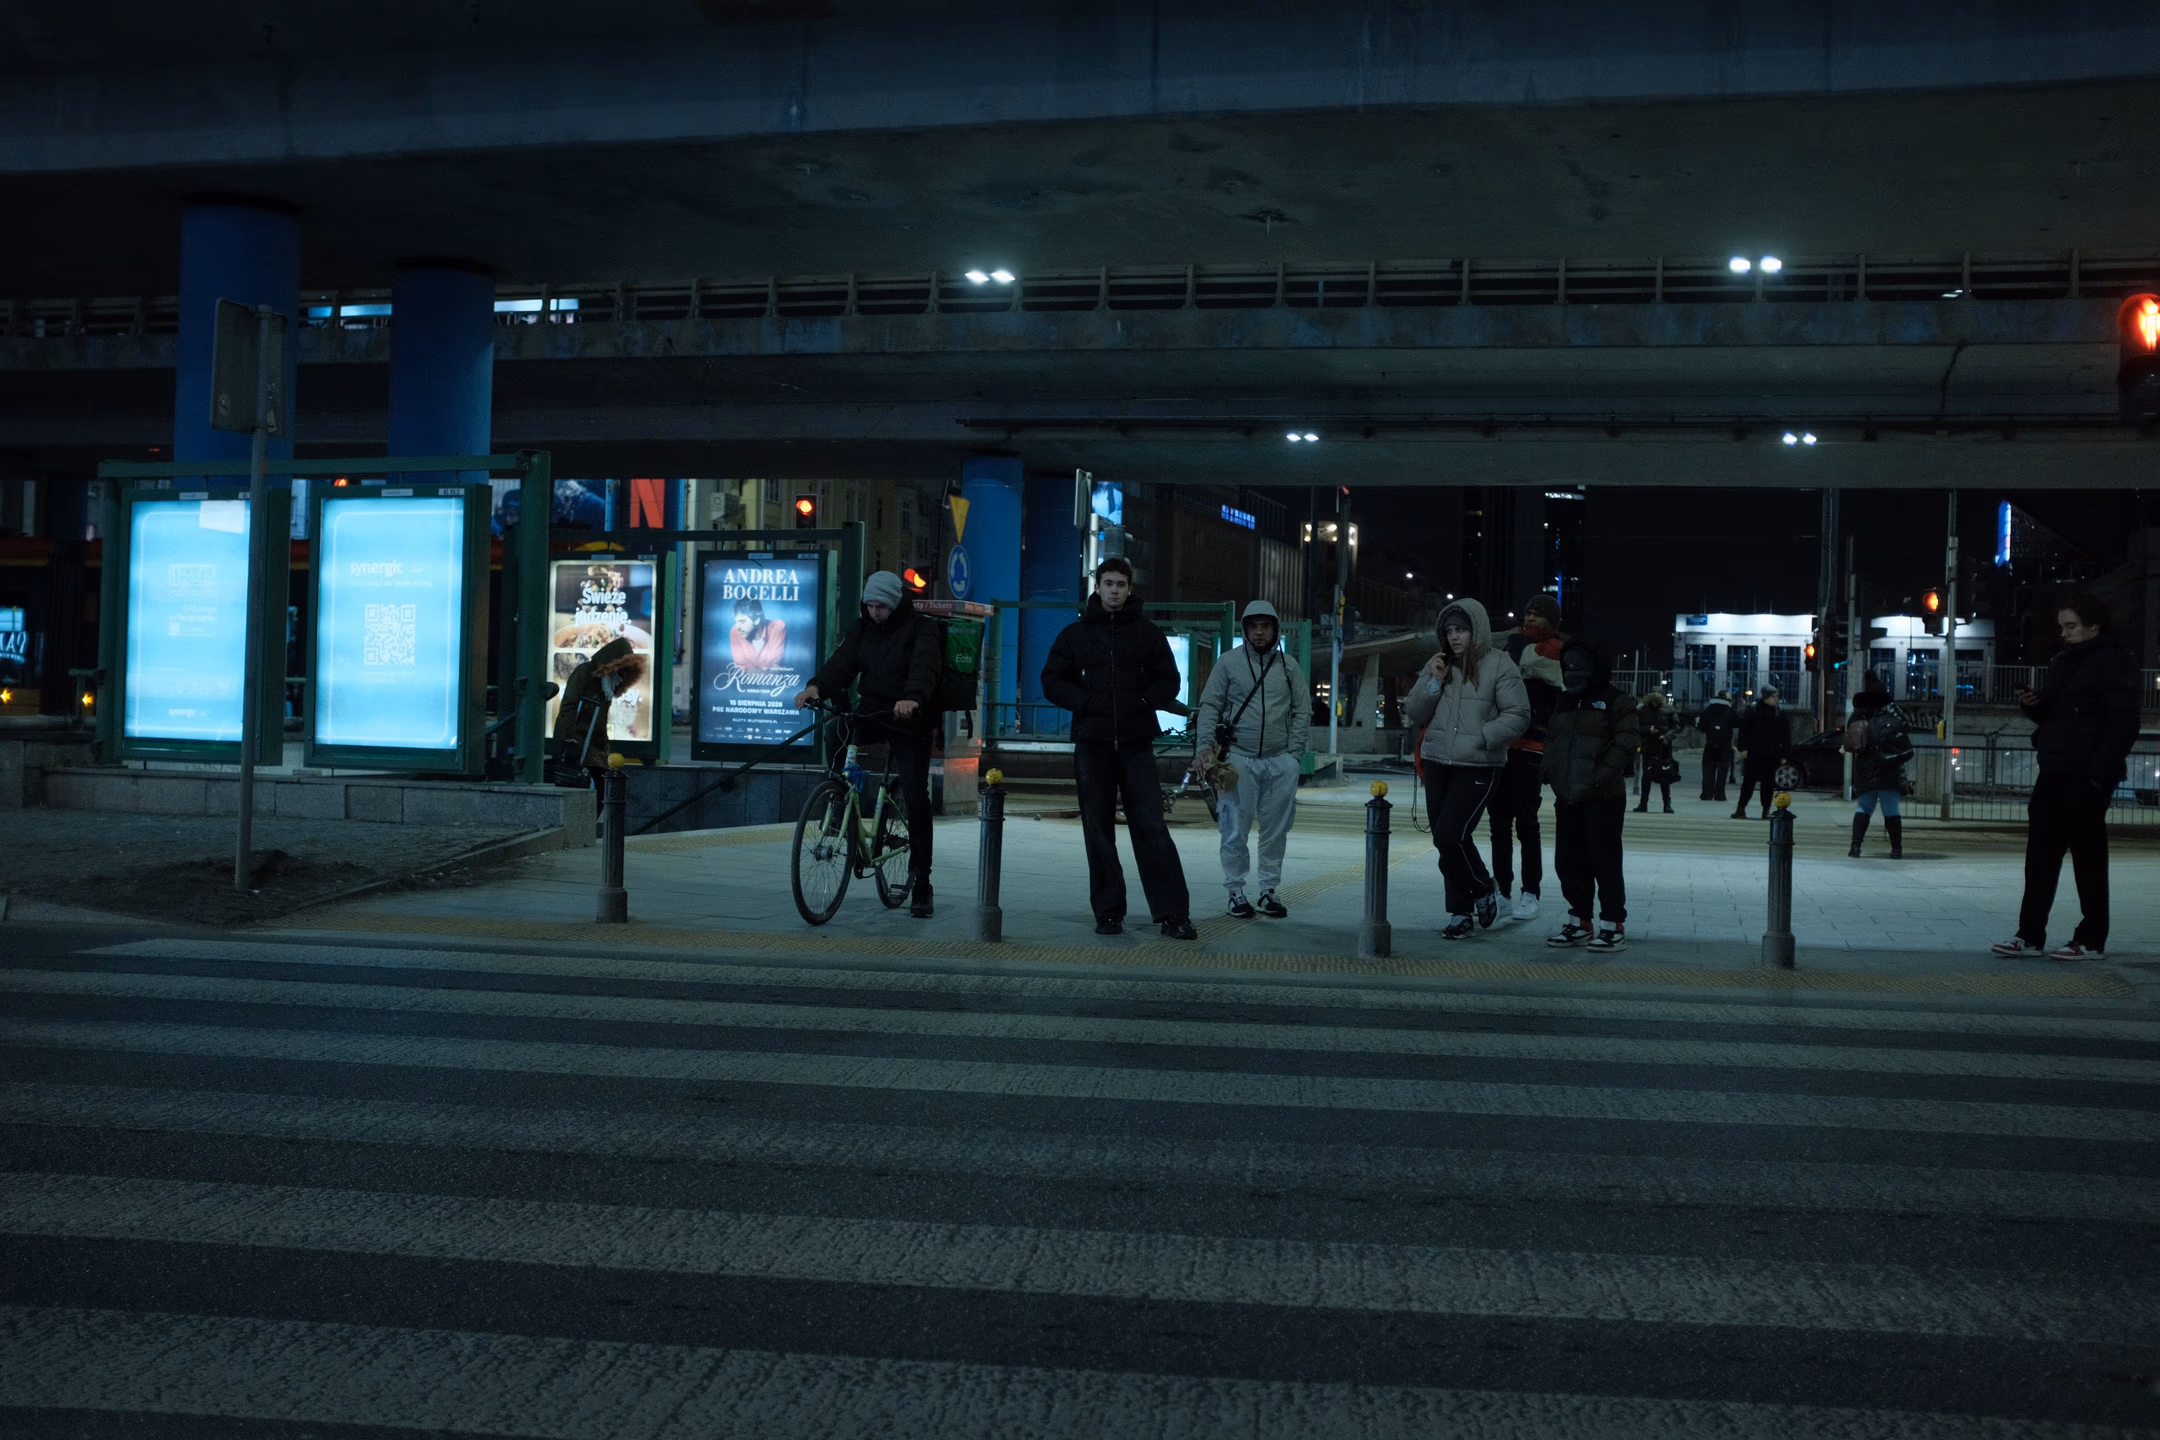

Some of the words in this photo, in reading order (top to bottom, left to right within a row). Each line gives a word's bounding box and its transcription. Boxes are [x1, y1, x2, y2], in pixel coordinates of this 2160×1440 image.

[629, 479, 665, 528] N
[350, 560, 404, 577] synergic
[723, 568, 800, 585] ANDREA
[582, 584, 627, 605] Świeże
[723, 585, 800, 601] BOCELLI
[955, 653, 973, 664] Eats
[713, 662, 800, 697] Romanza
[725, 707, 763, 715] NARODOWY
[763, 708, 800, 716] WARSZAWA
